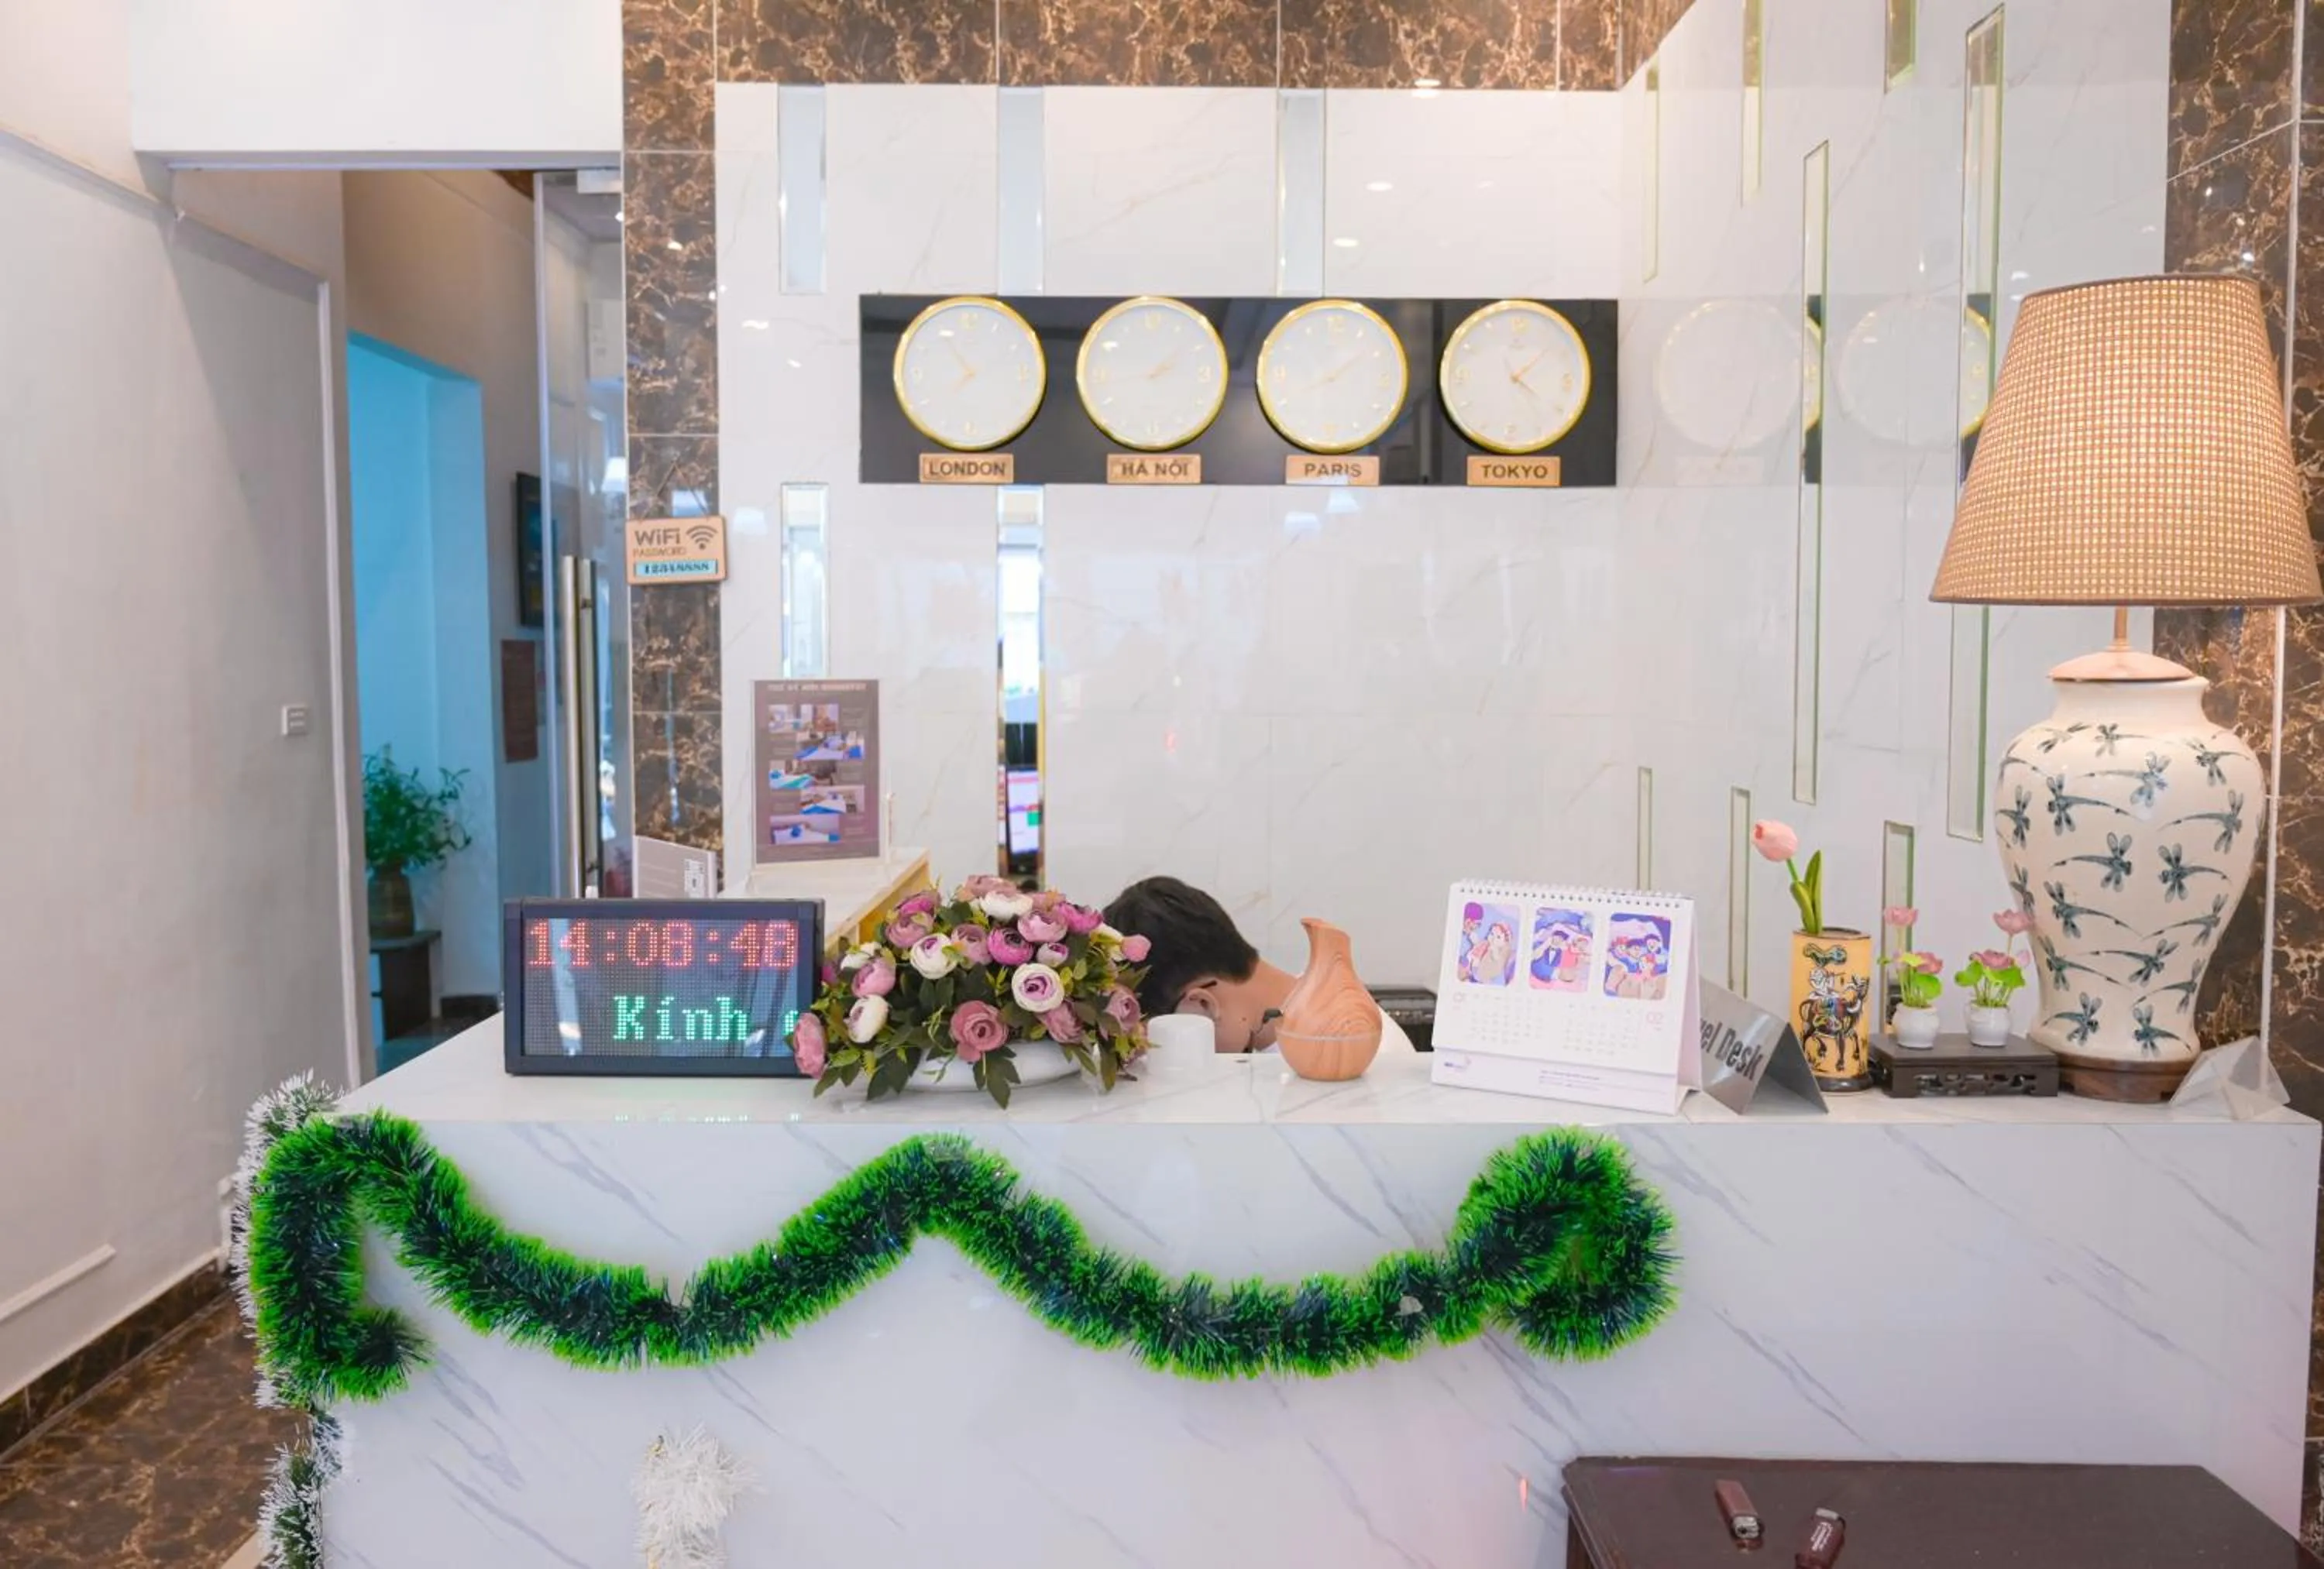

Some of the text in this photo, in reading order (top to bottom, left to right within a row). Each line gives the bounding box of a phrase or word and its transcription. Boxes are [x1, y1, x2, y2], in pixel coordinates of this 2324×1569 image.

[929, 461, 1006, 476] LONDON
[1305, 462, 1362, 478] PARIS
[1481, 465, 1549, 479] TOKYO
[634, 527, 680, 545] WiFi
[633, 547, 686, 557] PASSWORD
[528, 920, 797, 967] 14:08:48
[613, 995, 748, 1041] Kính
[1714, 1027, 1764, 1081] Desk
